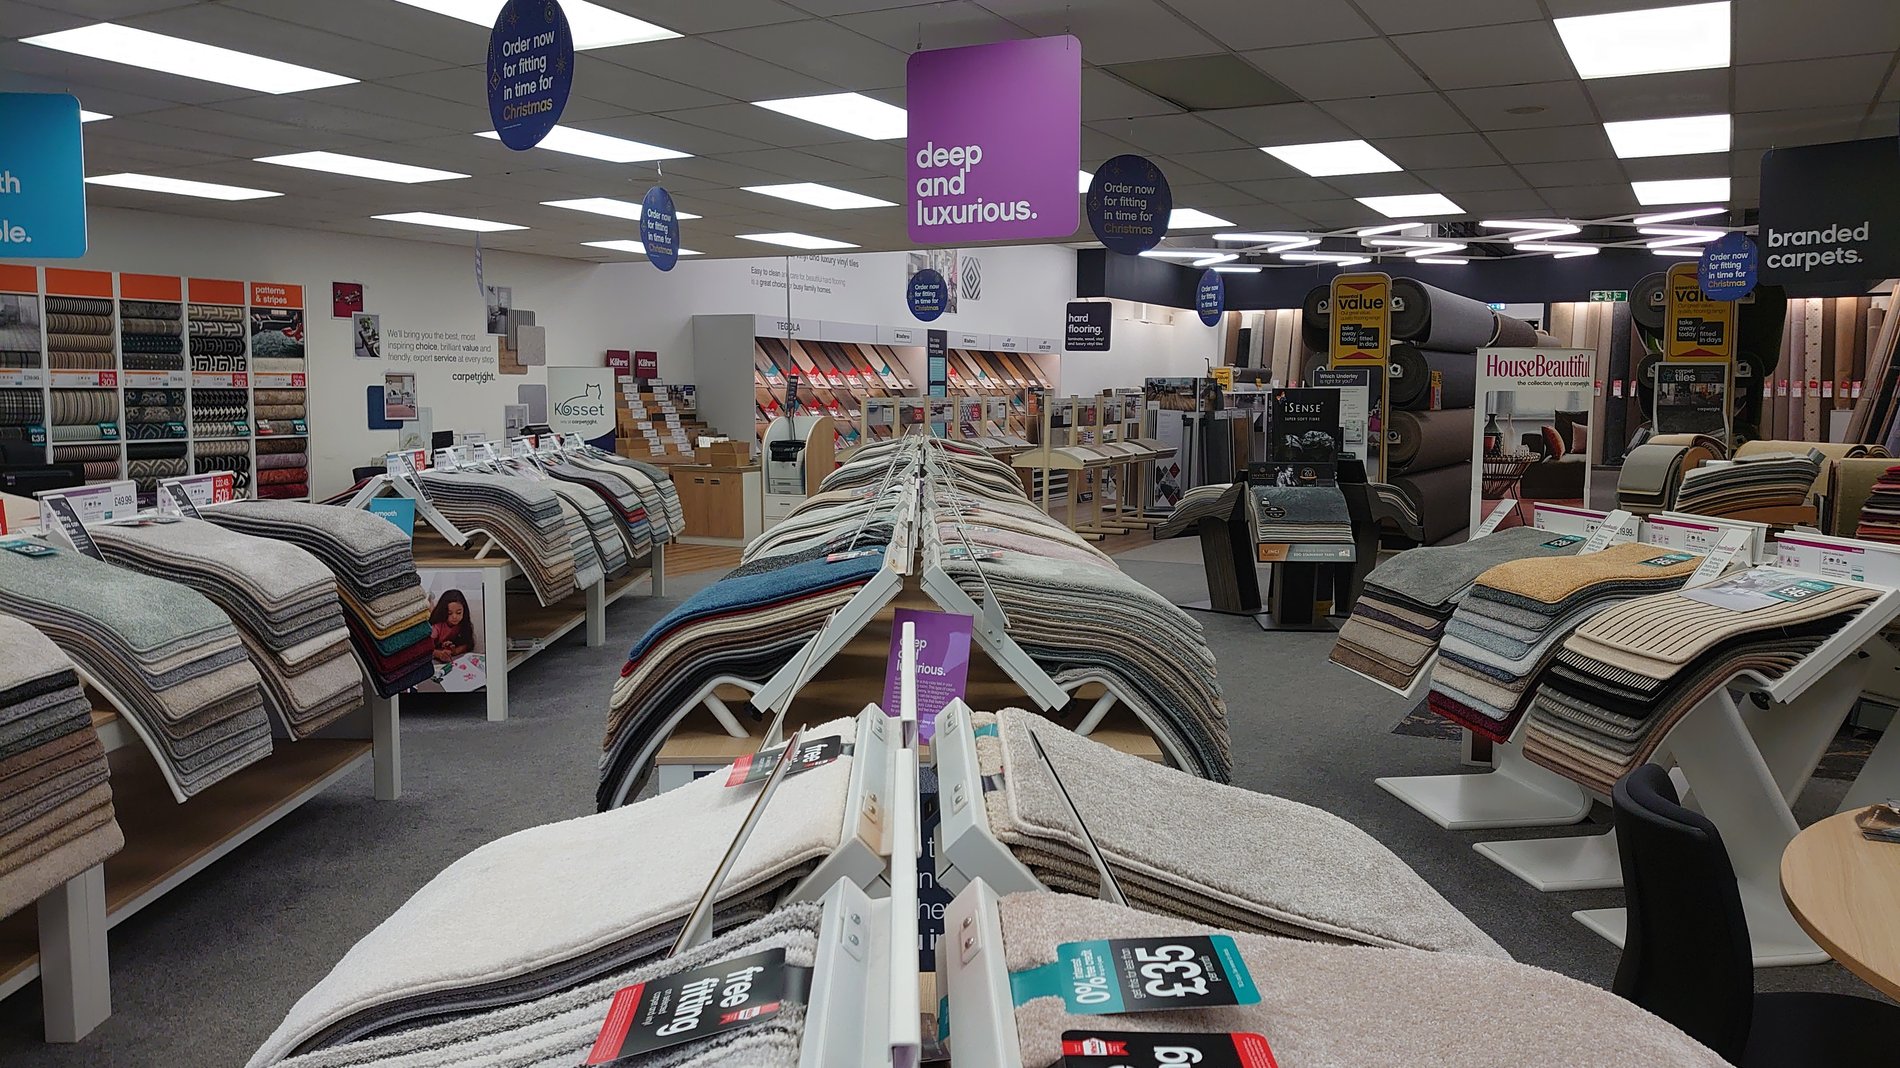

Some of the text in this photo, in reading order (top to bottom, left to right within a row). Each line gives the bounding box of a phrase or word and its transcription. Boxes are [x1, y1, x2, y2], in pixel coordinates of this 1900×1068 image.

[503, 30, 555, 57] Order now
[503, 55, 547, 78] for fitting
[503, 75, 553, 100] in time for
[503, 98, 553, 121] Christmas
[916, 141, 983, 173] deep
[916, 168, 965, 197] and
[1104, 182, 1156, 194] Order now
[1104, 196, 1147, 210] for fitting
[647, 208, 672, 222] Order now
[917, 197, 1038, 226] luxurious.
[1104, 210, 1153, 222] in time for
[0, 219, 32, 243] le.
[647, 220, 668, 235] for fitting
[1104, 223, 1154, 235] Christmas
[1768, 221, 1869, 248] branded
[648, 232, 653, 241] in
[653, 233, 664, 243] time
[1710, 252, 1749, 262] Order now
[1766, 247, 1863, 272] carpets.
[750, 266, 763, 277] Easy
[768, 269, 781, 277] clean
[1709, 261, 1742, 270] for fitting
[1708, 271, 1715, 279] in
[1716, 271, 1733, 279] time
[255, 287, 286, 295] patterns
[772, 280, 786, 288] choice
[793, 283, 804, 292] busy
[804, 285, 816, 294] family
[1708, 280, 1746, 288] Christmas
[255, 295, 288, 306] & stripes
[1338, 294, 1384, 310] value
[1068, 313, 1089, 323] hard
[403, 330, 420, 341] bring
[421, 332, 433, 341] you
[433, 332, 444, 340] the
[1068, 324, 1103, 336] flooring.
[387, 341, 414, 351] inspiring
[415, 342, 439, 351] choice,
[440, 344, 461, 352] brilliant
[462, 344, 479, 352] value
[387, 353, 411, 363] friendly,
[412, 354, 433, 363] expert
[433, 354, 457, 362] service
[457, 355, 464, 363] at
[464, 357, 481, 365] every
[1486, 353, 1591, 378] HouseBeautiful
[452, 371, 496, 384] carpetright.
[1674, 373, 1696, 382] tiles
[554, 402, 605, 417] Kosset
[803, 743, 829, 763] free
[1071, 957, 1083, 979] interest
[1081, 948, 1097, 979] free credit
[1134, 944, 1210, 997] £35
[1121, 947, 1146, 999] get this for less than
[719, 965, 765, 1008] free
[1074, 975, 1111, 1005] 0%
[655, 977, 720, 1037] fitting
